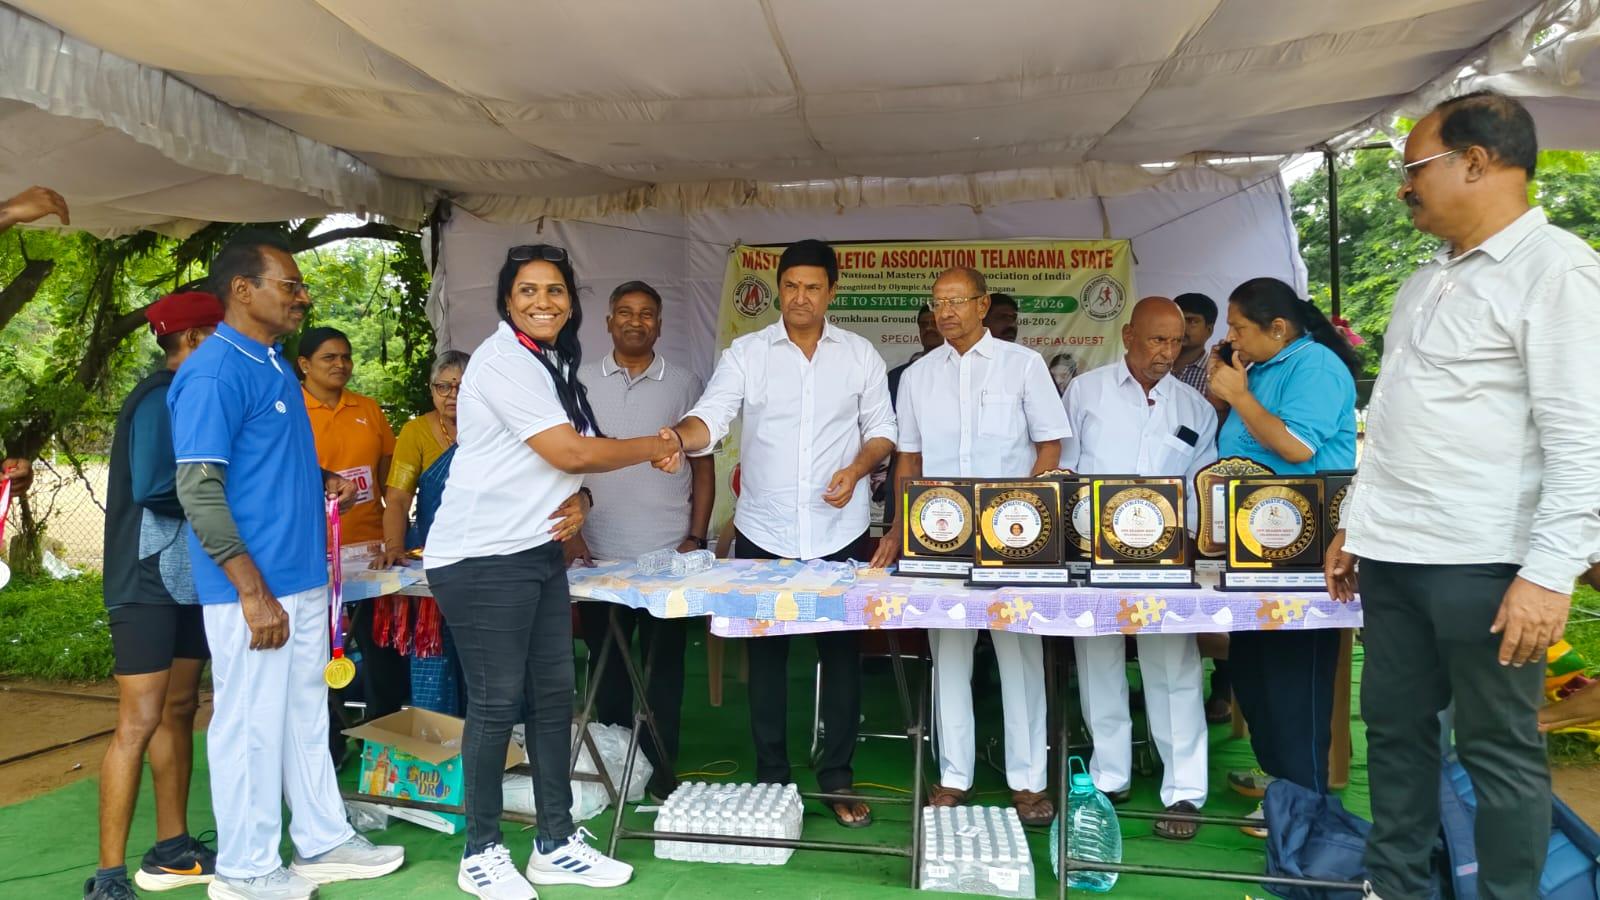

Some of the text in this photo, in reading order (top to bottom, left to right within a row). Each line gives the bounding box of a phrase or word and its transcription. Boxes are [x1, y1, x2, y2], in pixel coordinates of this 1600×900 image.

[742, 249, 1114, 271] MAST LETIC ASSOCIATION TELANGANA STATE
[841, 271, 883, 279] National
[886, 271, 926, 279] Masters
[984, 272, 1029, 281] sociation
[1032, 272, 1042, 281] of
[1044, 272, 1071, 281] India
[878, 284, 886, 292] by
[889, 284, 920, 292] Olympic
[850, 296, 867, 306] TO
[870, 296, 907, 306] STATE
[1033, 298, 1064, 309] 2026
[829, 314, 879, 324] Gymkhana
[1017, 318, 1057, 326] 08-2026
[881, 334, 1104, 345] SPECIA SPECIAL GUEST
